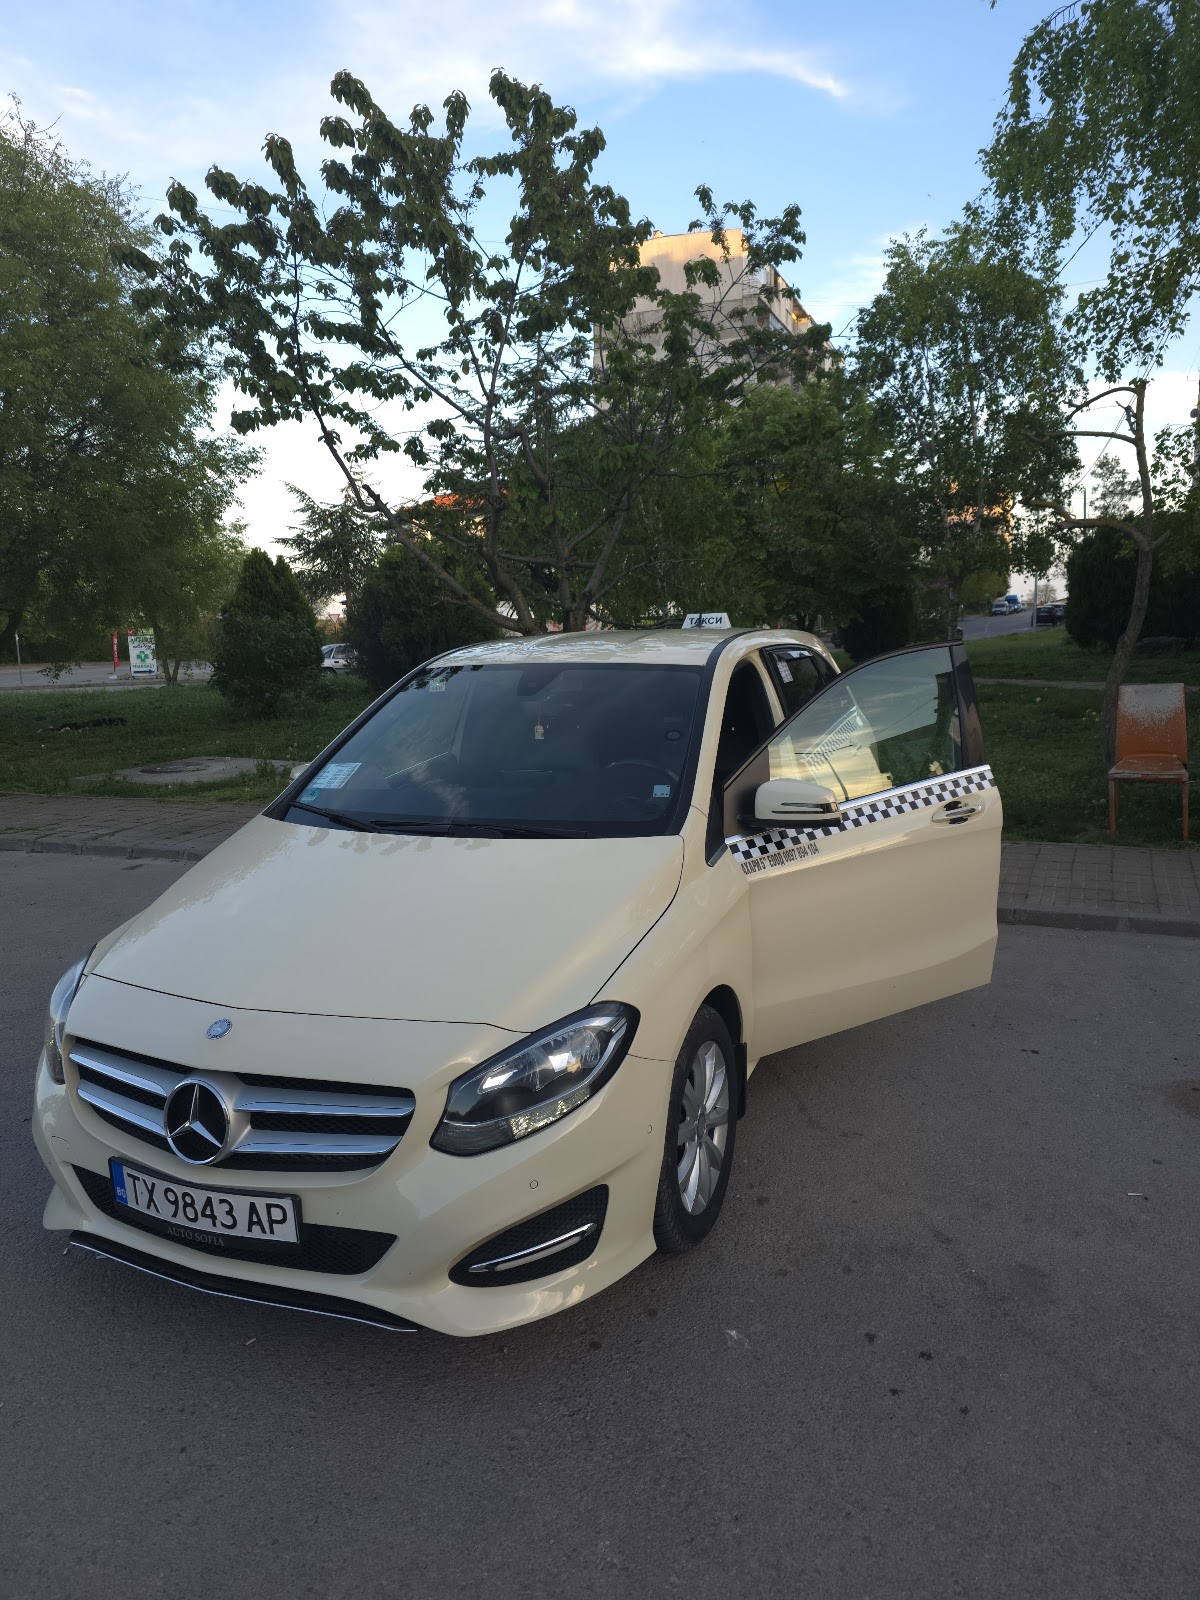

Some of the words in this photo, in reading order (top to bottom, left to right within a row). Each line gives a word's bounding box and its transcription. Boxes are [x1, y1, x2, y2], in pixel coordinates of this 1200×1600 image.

[116, 1186, 127, 1199] BG
[163, 1186, 238, 1230] 9843
[247, 1201, 288, 1235] AP
[167, 1226, 193, 1240] AUTO
[194, 1232, 225, 1247] SOFIA
